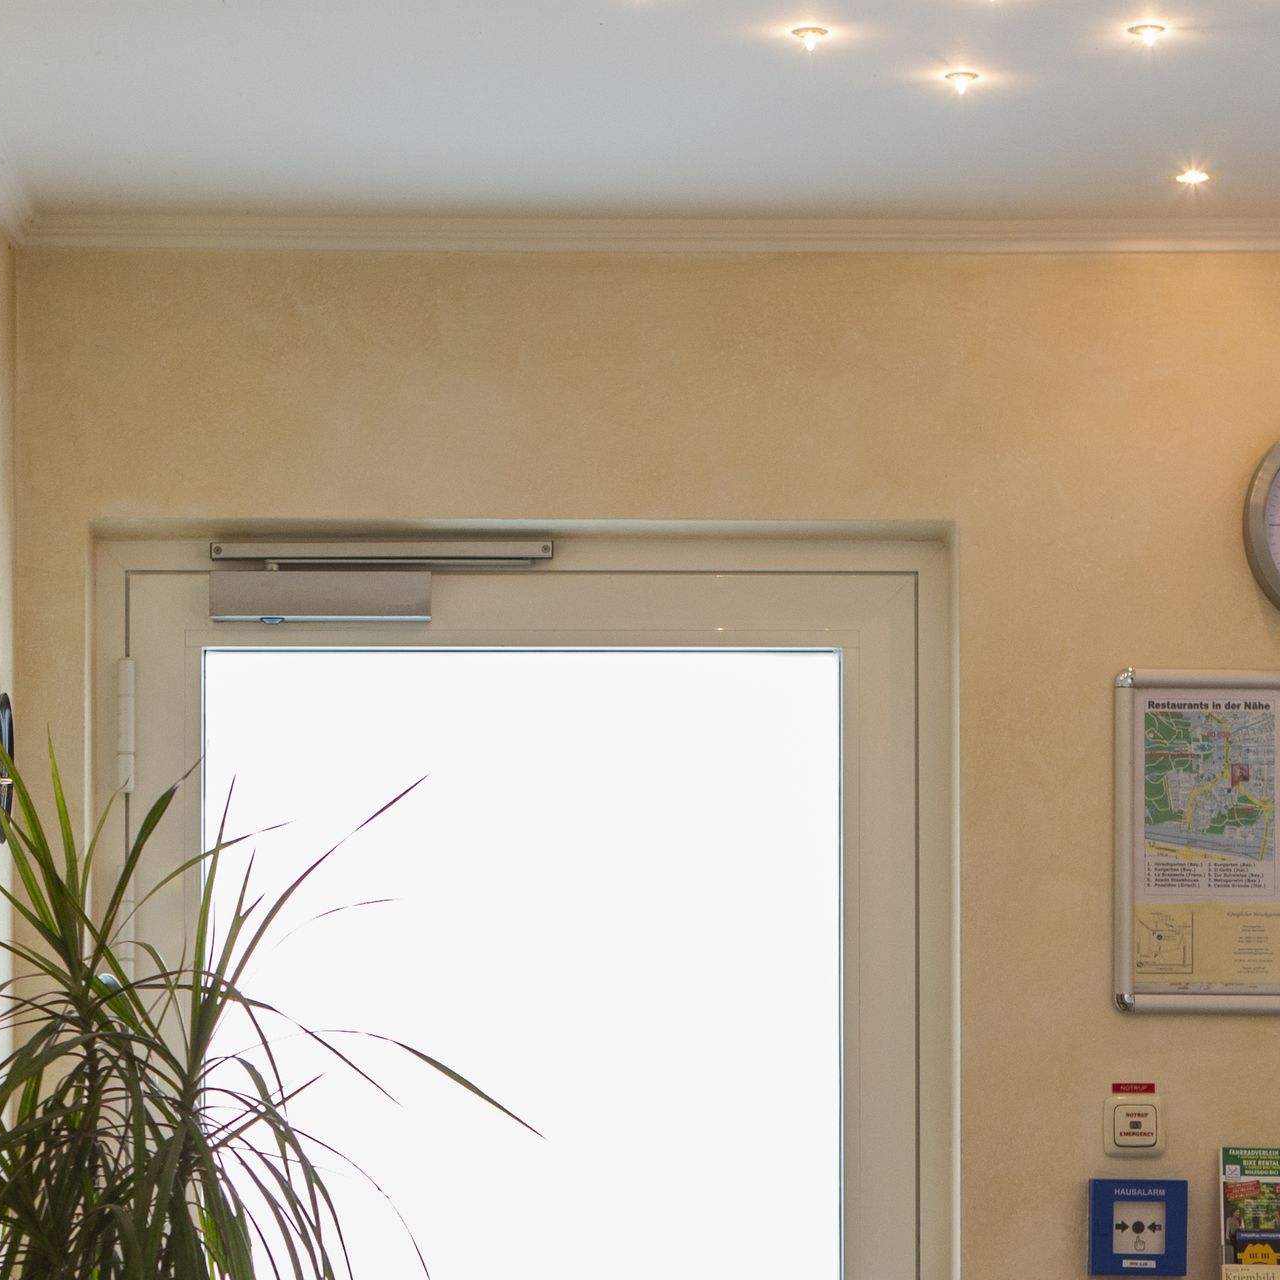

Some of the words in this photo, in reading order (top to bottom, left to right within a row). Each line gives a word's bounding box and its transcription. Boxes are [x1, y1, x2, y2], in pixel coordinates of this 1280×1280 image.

[1147, 701, 1209, 710] Restaurants
[1212, 701, 1222, 710] in
[1225, 701, 1241, 710] der
[1244, 701, 1271, 711] Nähe
[1114, 1188, 1166, 1196] HAUSALARM
